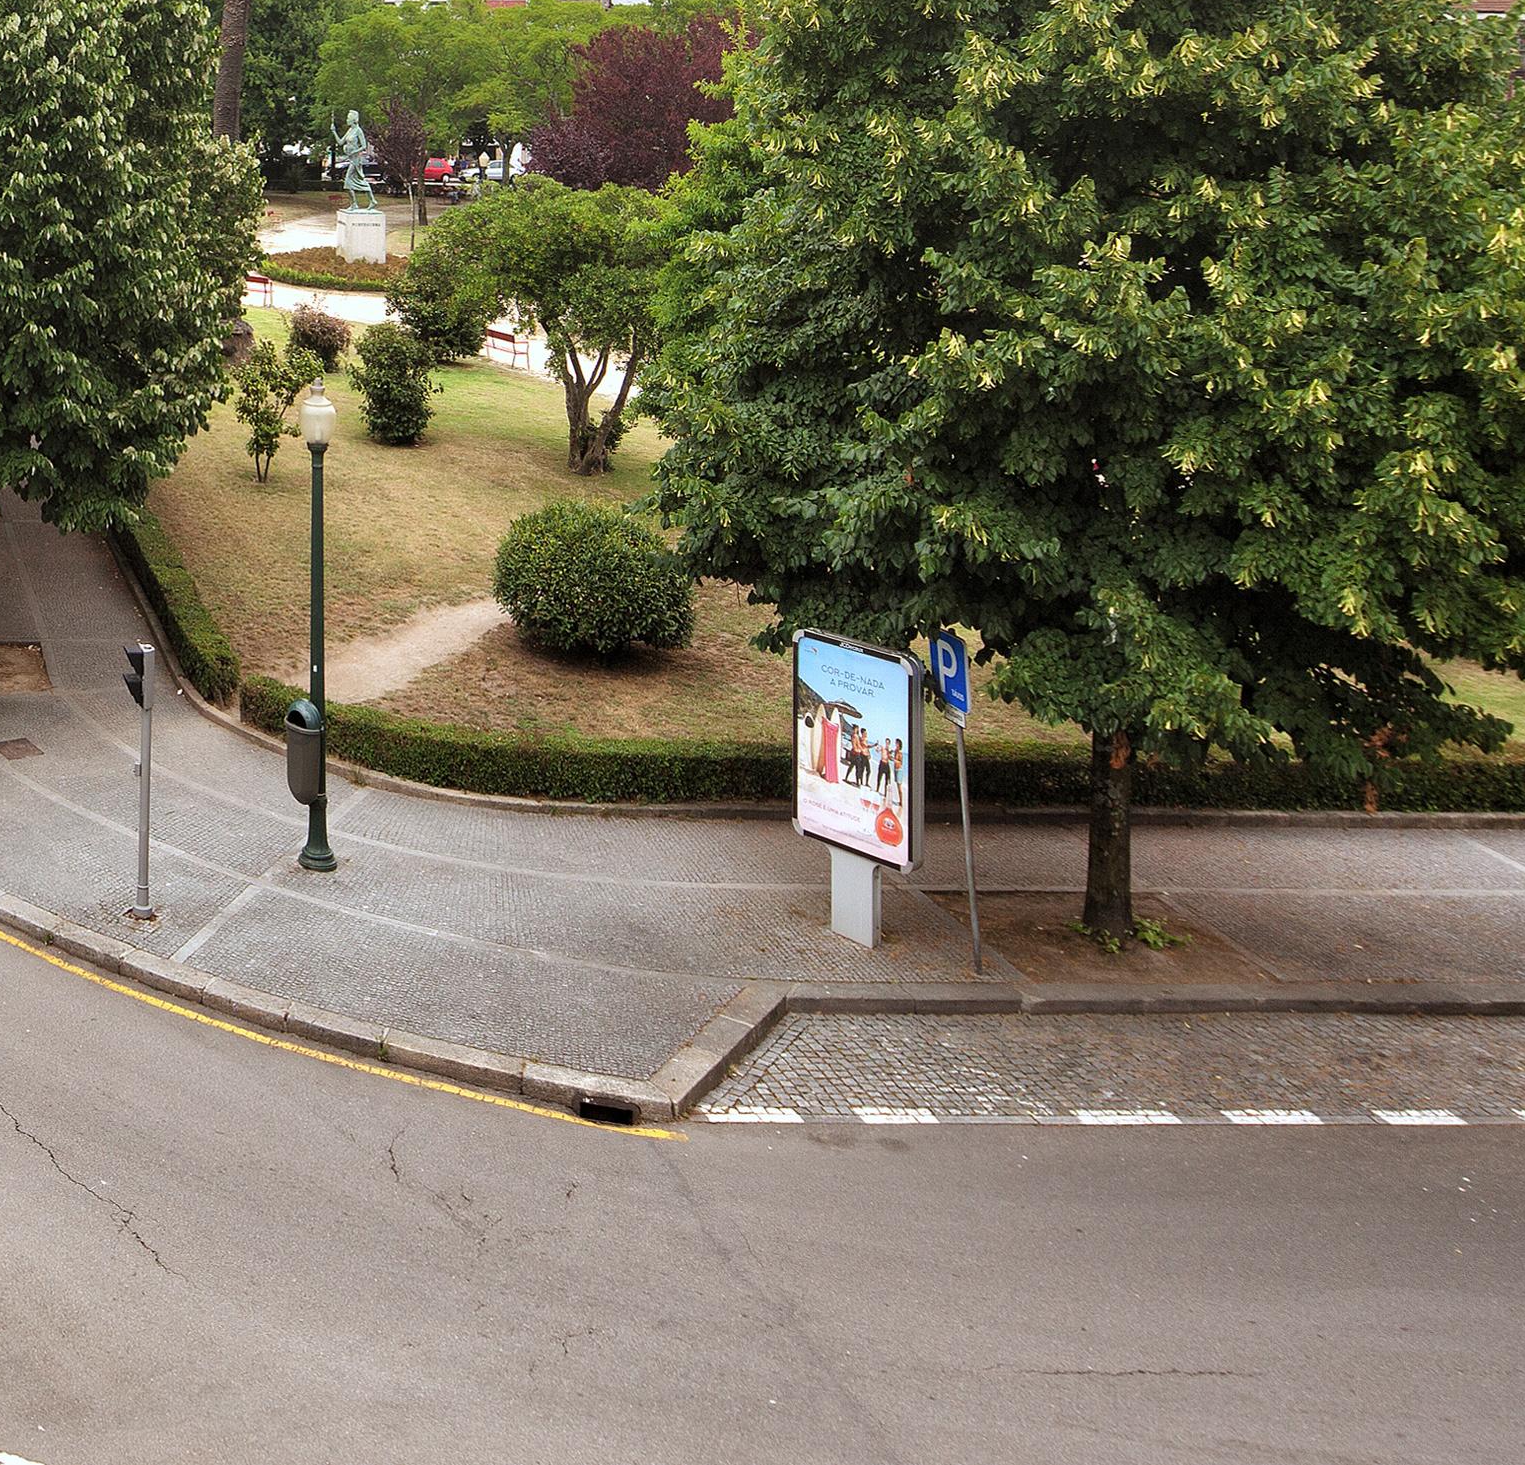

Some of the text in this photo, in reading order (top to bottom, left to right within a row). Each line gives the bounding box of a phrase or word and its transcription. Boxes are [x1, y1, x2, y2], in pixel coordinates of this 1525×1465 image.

[820, 664, 886, 690] COR-DE-NADA
[937, 639, 958, 693] P
[830, 678, 875, 697] A PROVAR
